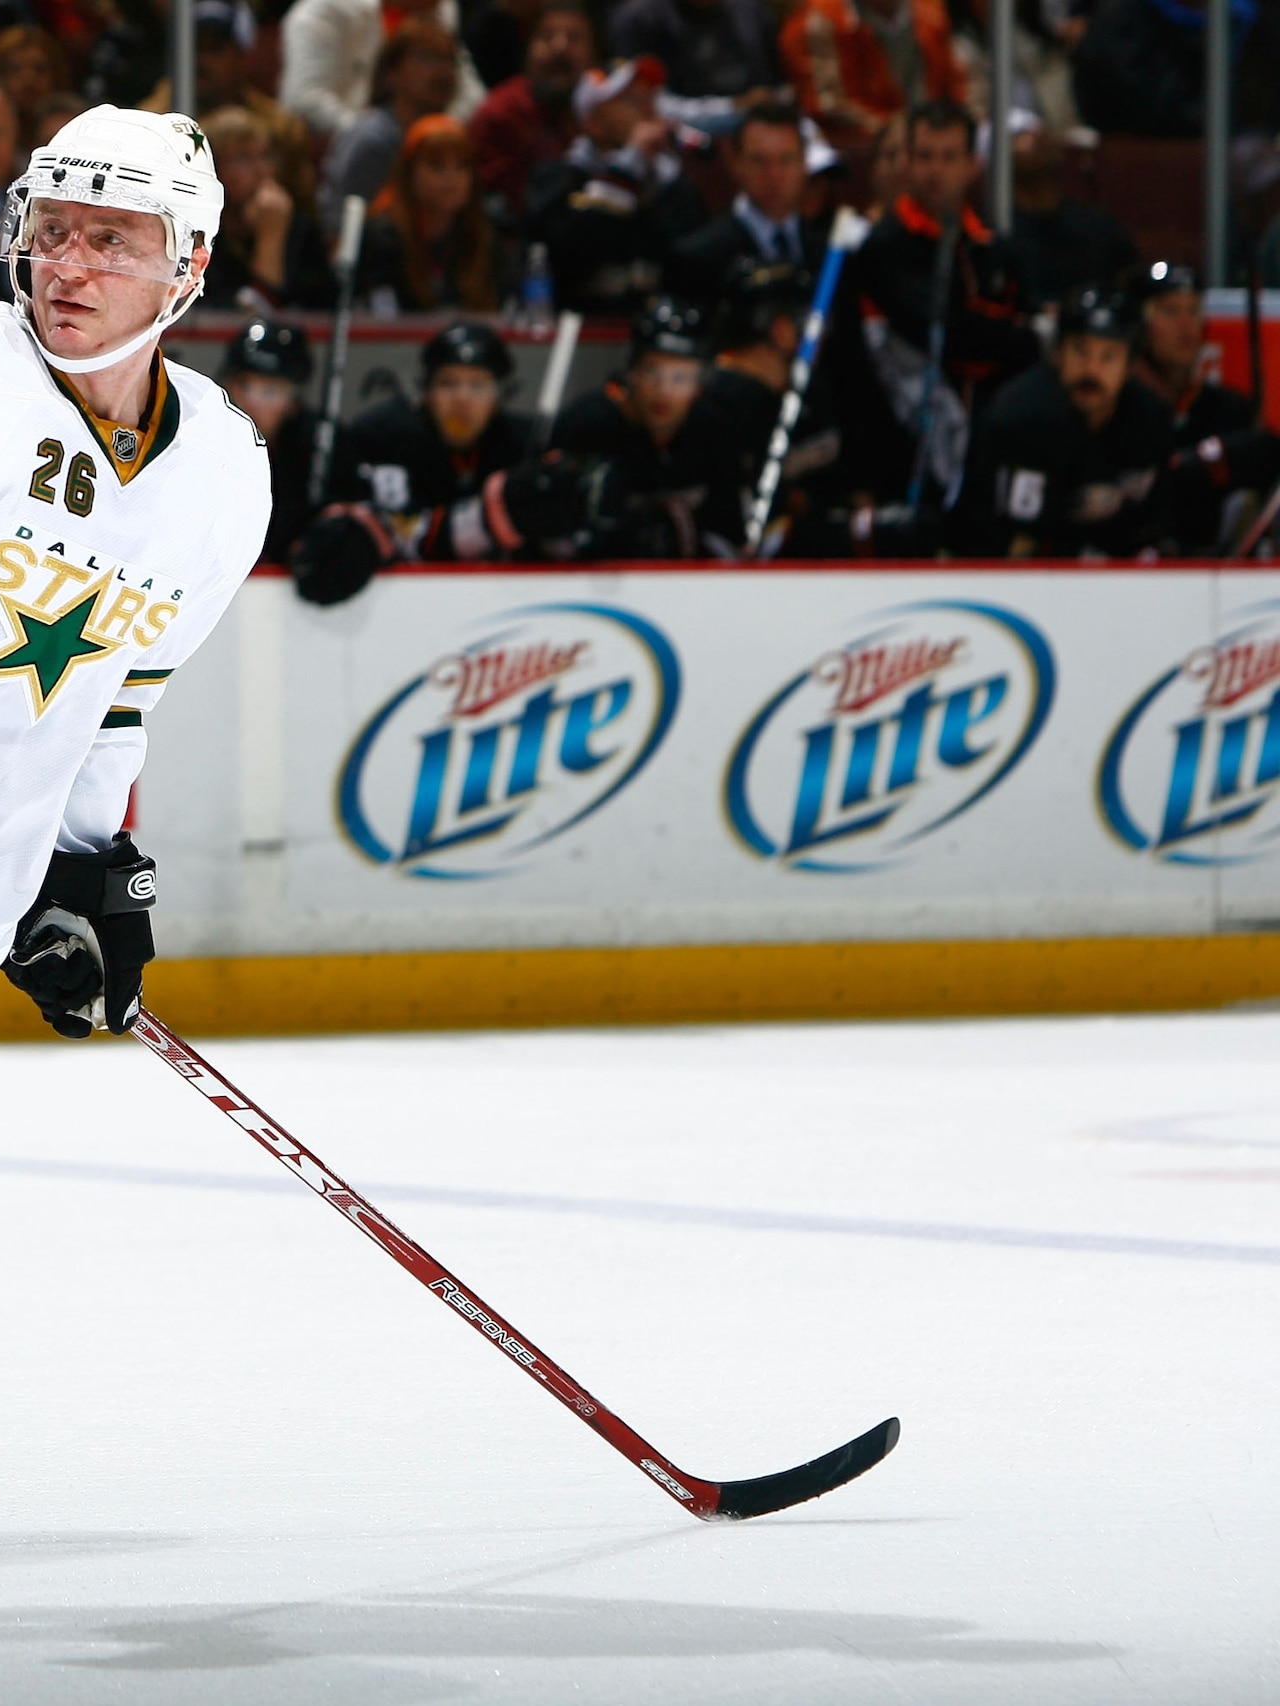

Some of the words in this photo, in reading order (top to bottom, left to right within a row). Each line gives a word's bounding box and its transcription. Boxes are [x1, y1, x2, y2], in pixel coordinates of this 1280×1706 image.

[59, 156, 113, 172] BAUER
[29, 437, 97, 518] 26
[117, 438, 135, 454] NHL
[16, 526, 183, 601] DALLAS
[429, 640, 590, 717] Miller
[814, 636, 968, 714] Miller
[397, 677, 633, 863] Lite
[782, 672, 1009, 858] Lite
[188, 1062, 345, 1195] TPS
[429, 1276, 538, 1365] RESPONSE
